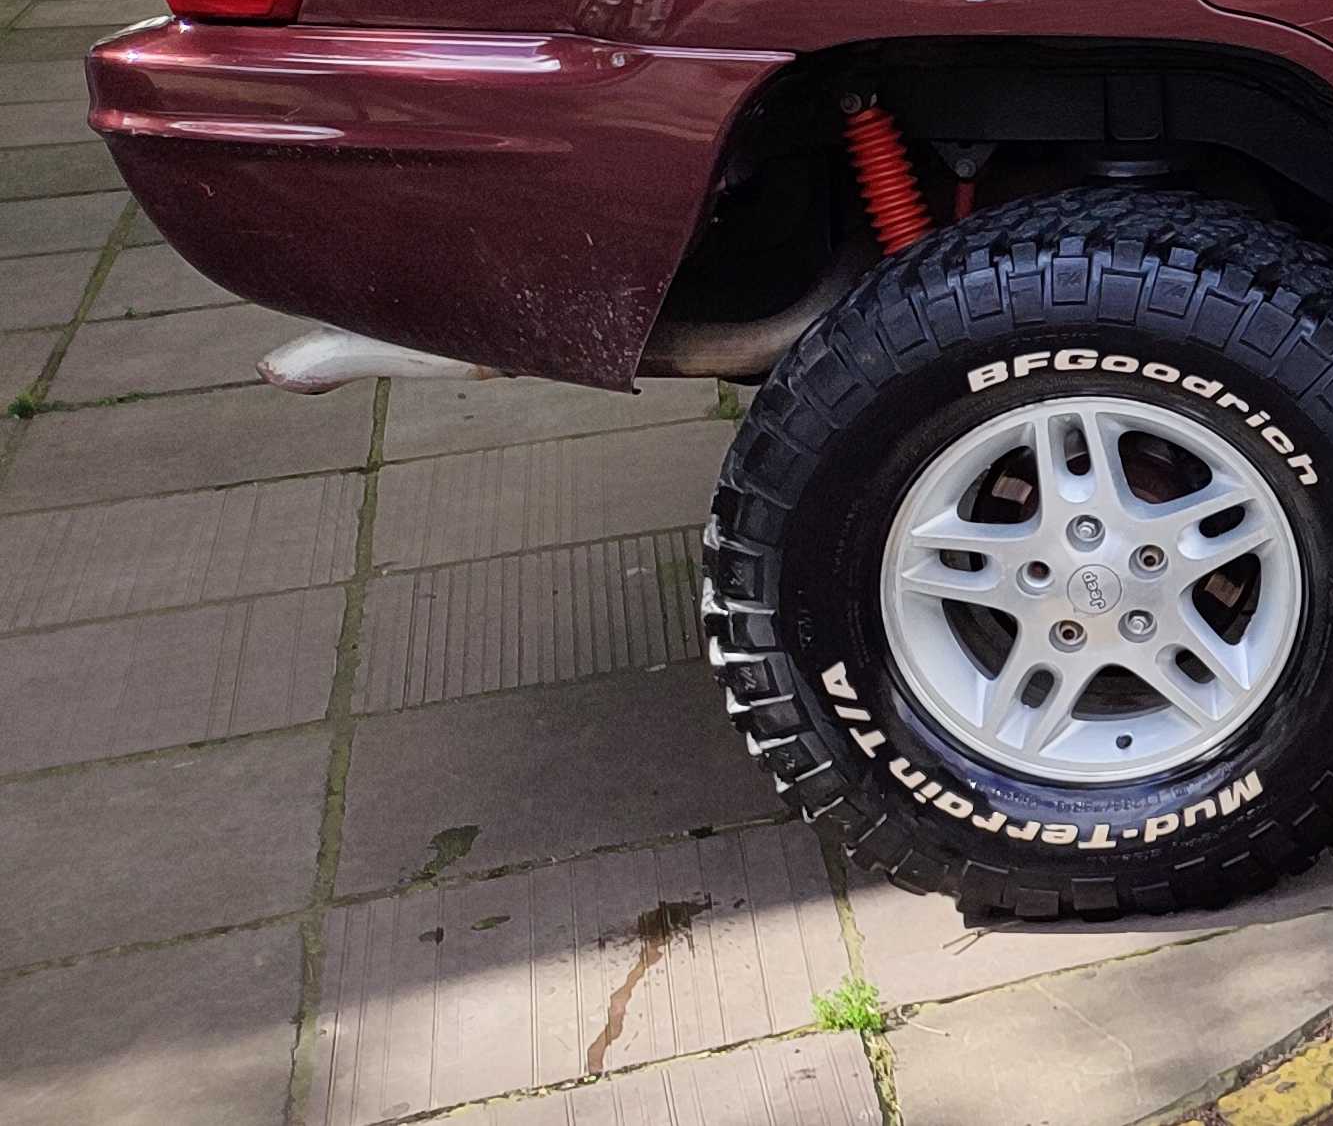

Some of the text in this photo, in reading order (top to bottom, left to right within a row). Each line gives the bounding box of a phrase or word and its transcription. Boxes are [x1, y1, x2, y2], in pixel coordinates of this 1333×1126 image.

[966, 348, 1320, 486] BFGoodrich
[1082, 571, 1106, 610] Jeep
[820, 660, 887, 760] T/A
